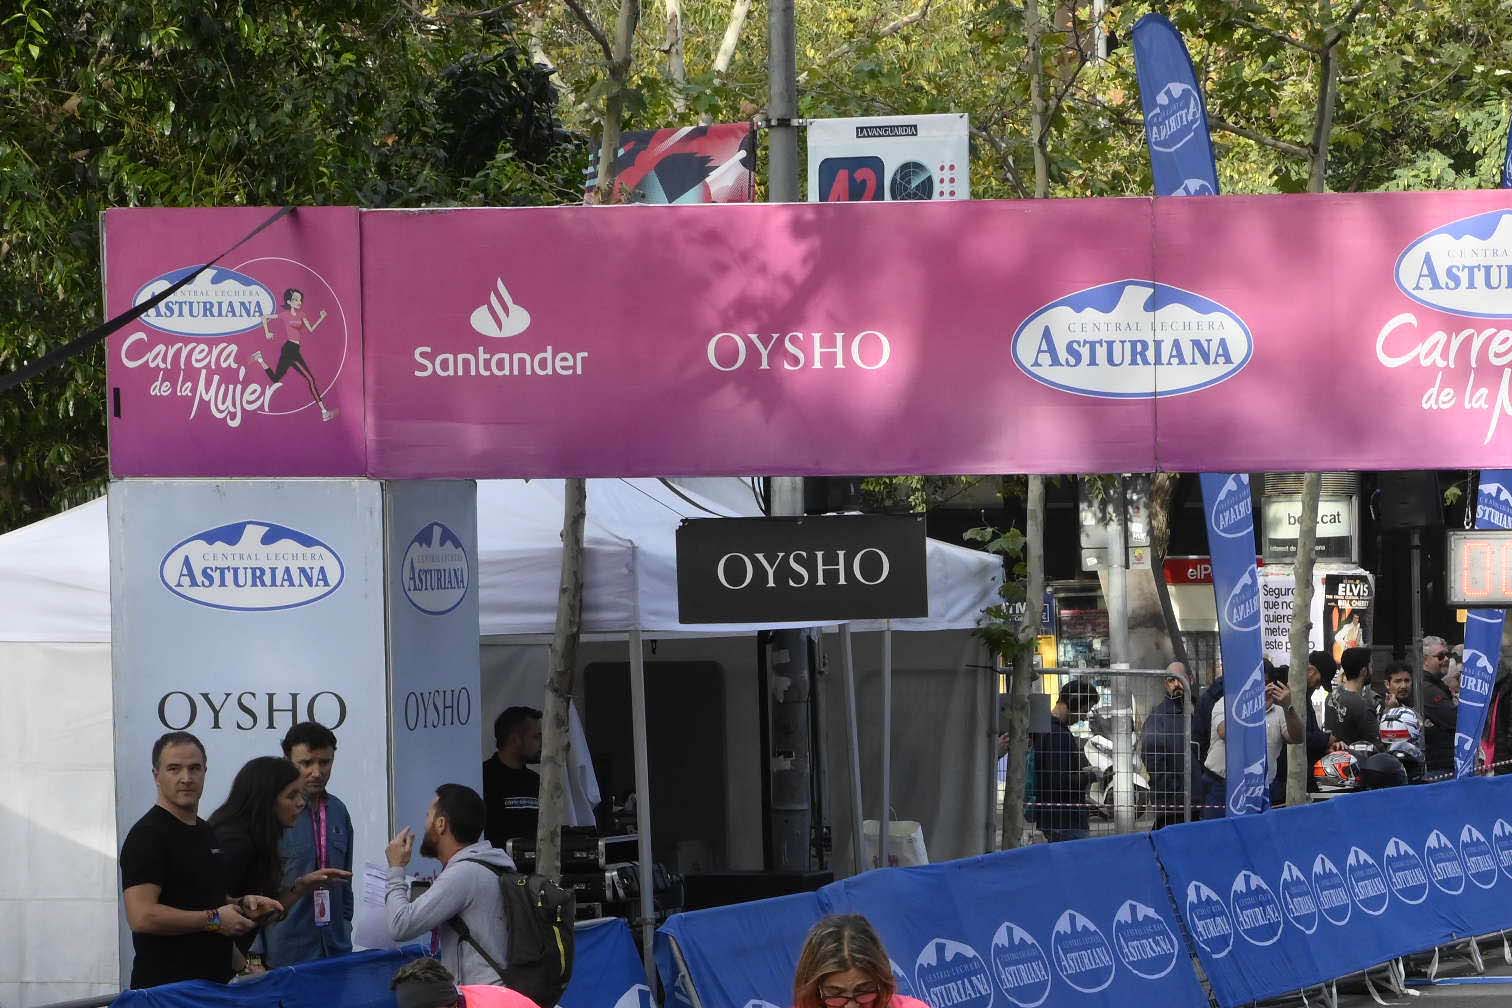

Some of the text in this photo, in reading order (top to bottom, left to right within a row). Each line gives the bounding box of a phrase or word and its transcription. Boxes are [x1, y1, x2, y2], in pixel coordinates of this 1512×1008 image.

[868, 126, 917, 137] VANGUARDIA
[144, 291, 265, 318] ASTURIANA
[172, 289, 261, 298] ENTRAL LECHERA
[1067, 320, 1226, 333] CENTRAL LECHERA
[121, 331, 238, 369] Carrera
[414, 346, 588, 377] Santander
[707, 331, 891, 372] OYSHO
[1031, 325, 1235, 368] ASTURIANA
[150, 366, 283, 428] de la Mujer
[1421, 372, 1456, 410] de
[1464, 367, 1489, 410] la
[174, 554, 331, 589] ASTURIANA
[202, 552, 325, 562] CENTRAL LECHERA
[407, 556, 466, 592] ASTURIANA
[717, 548, 890, 590] OYSHO
[1338, 583, 1369, 596] ELVIS
[1263, 601, 1281, 614] que
[157, 691, 348, 732] OYSHO
[404, 687, 472, 732] OYSHO
